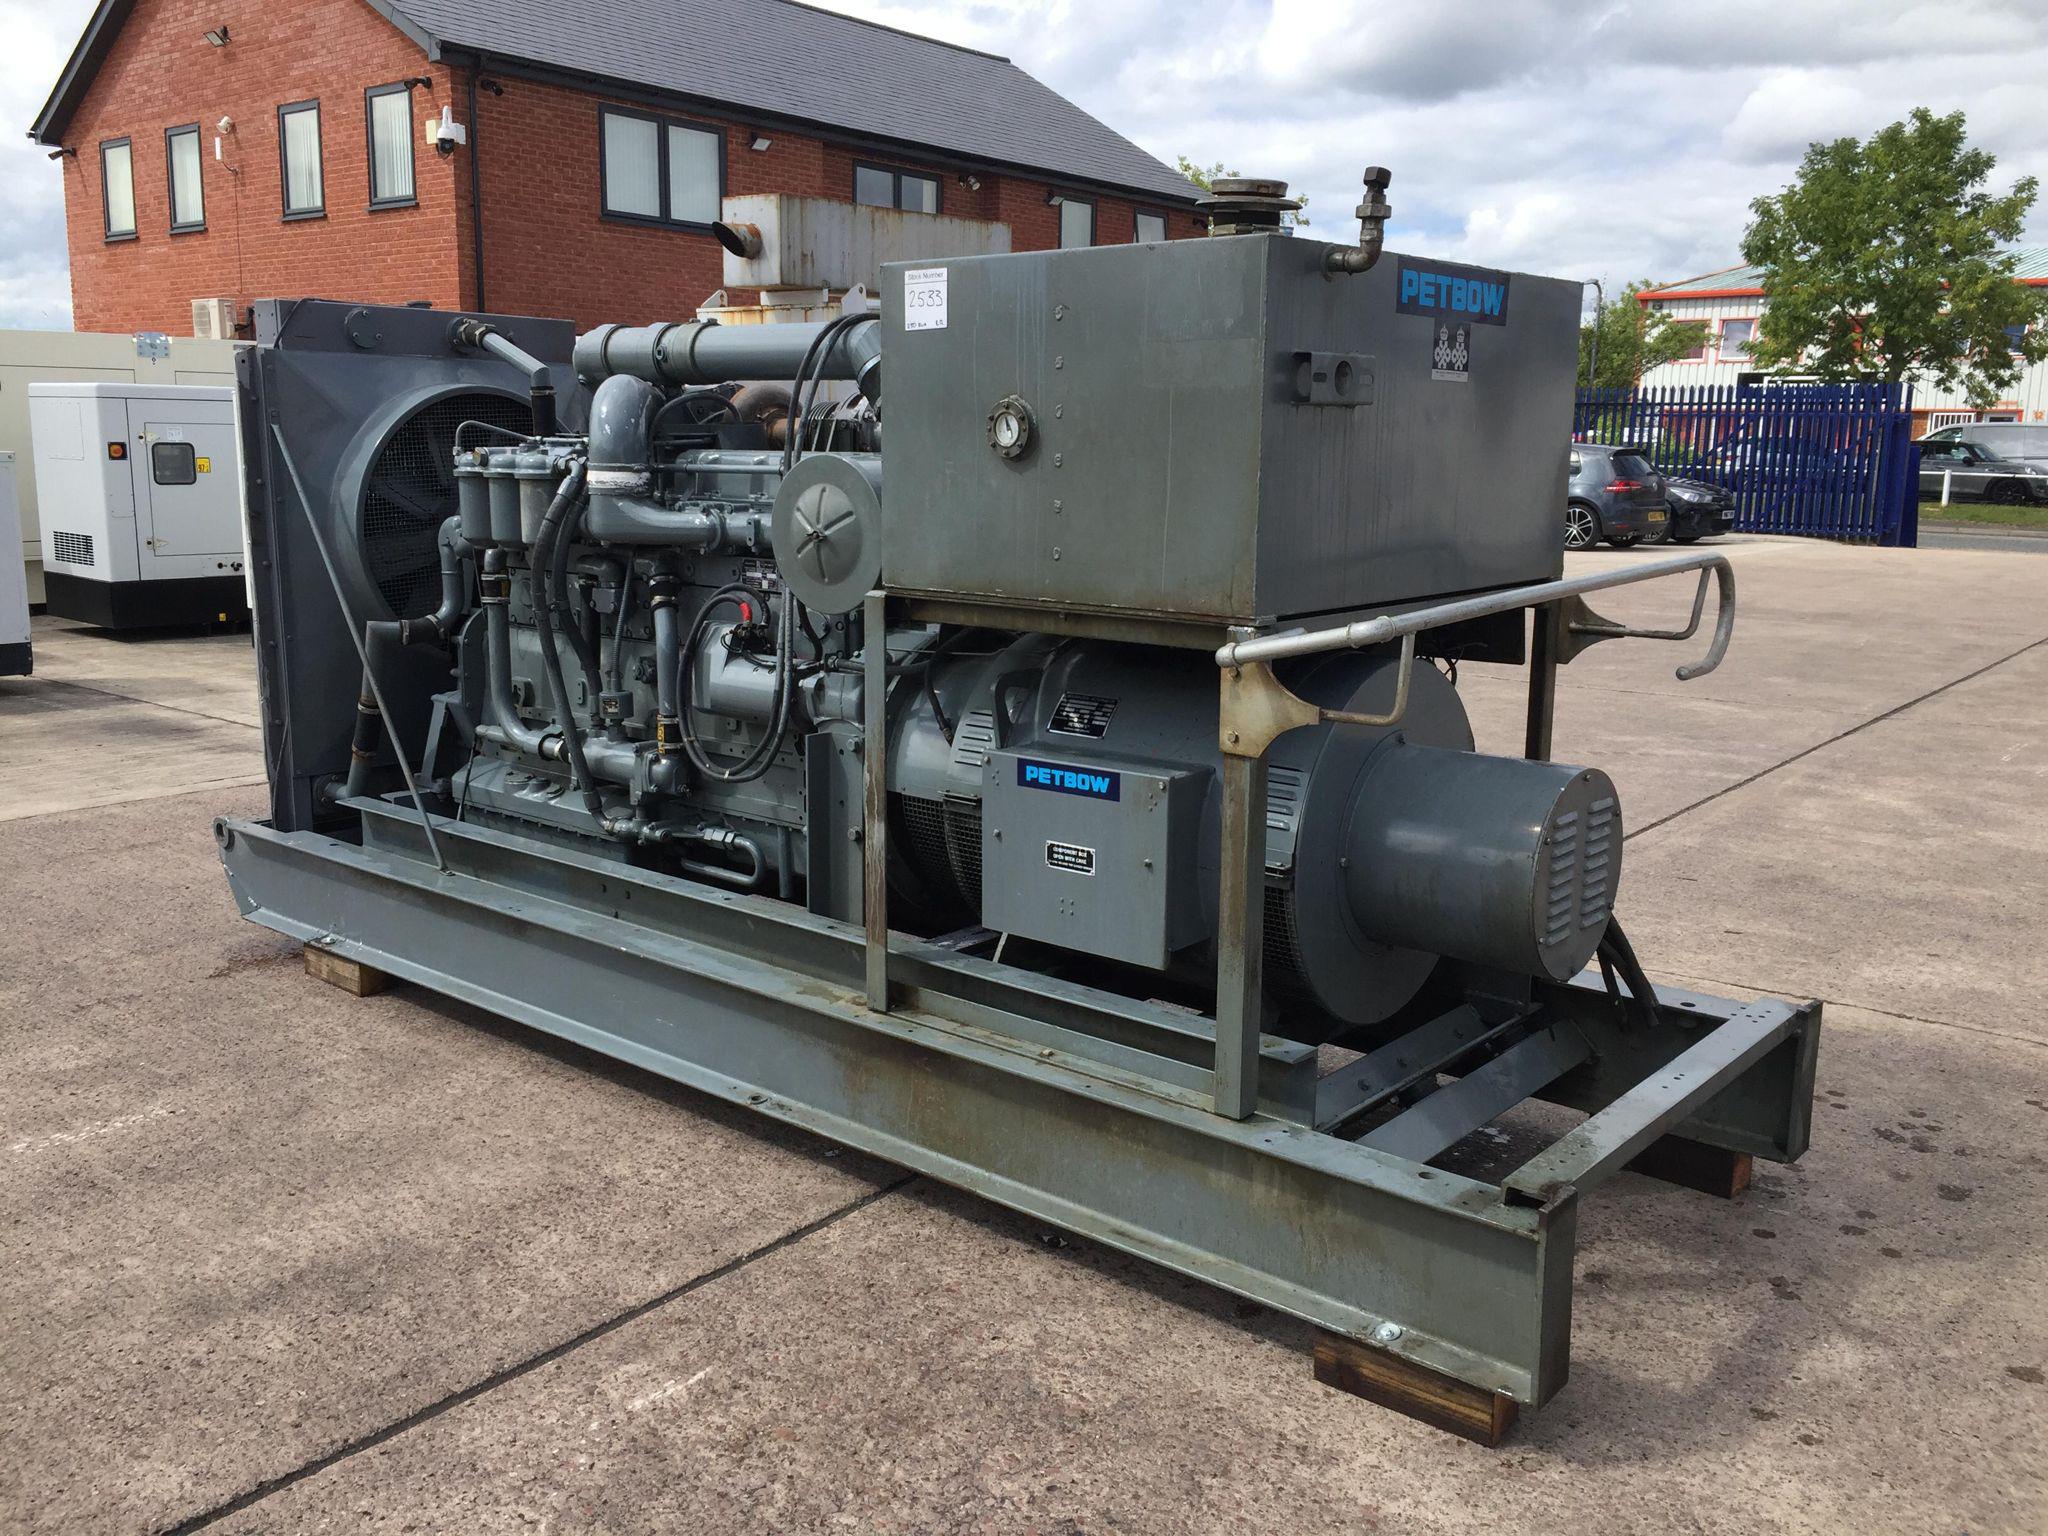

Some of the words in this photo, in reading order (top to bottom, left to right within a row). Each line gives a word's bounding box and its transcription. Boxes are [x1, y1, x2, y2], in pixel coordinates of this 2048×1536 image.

[922, 271, 944, 279] Number
[909, 289, 943, 308] 2533
[1401, 268, 1505, 316] PETBOW
[1025, 765, 1110, 794] PETBOW
